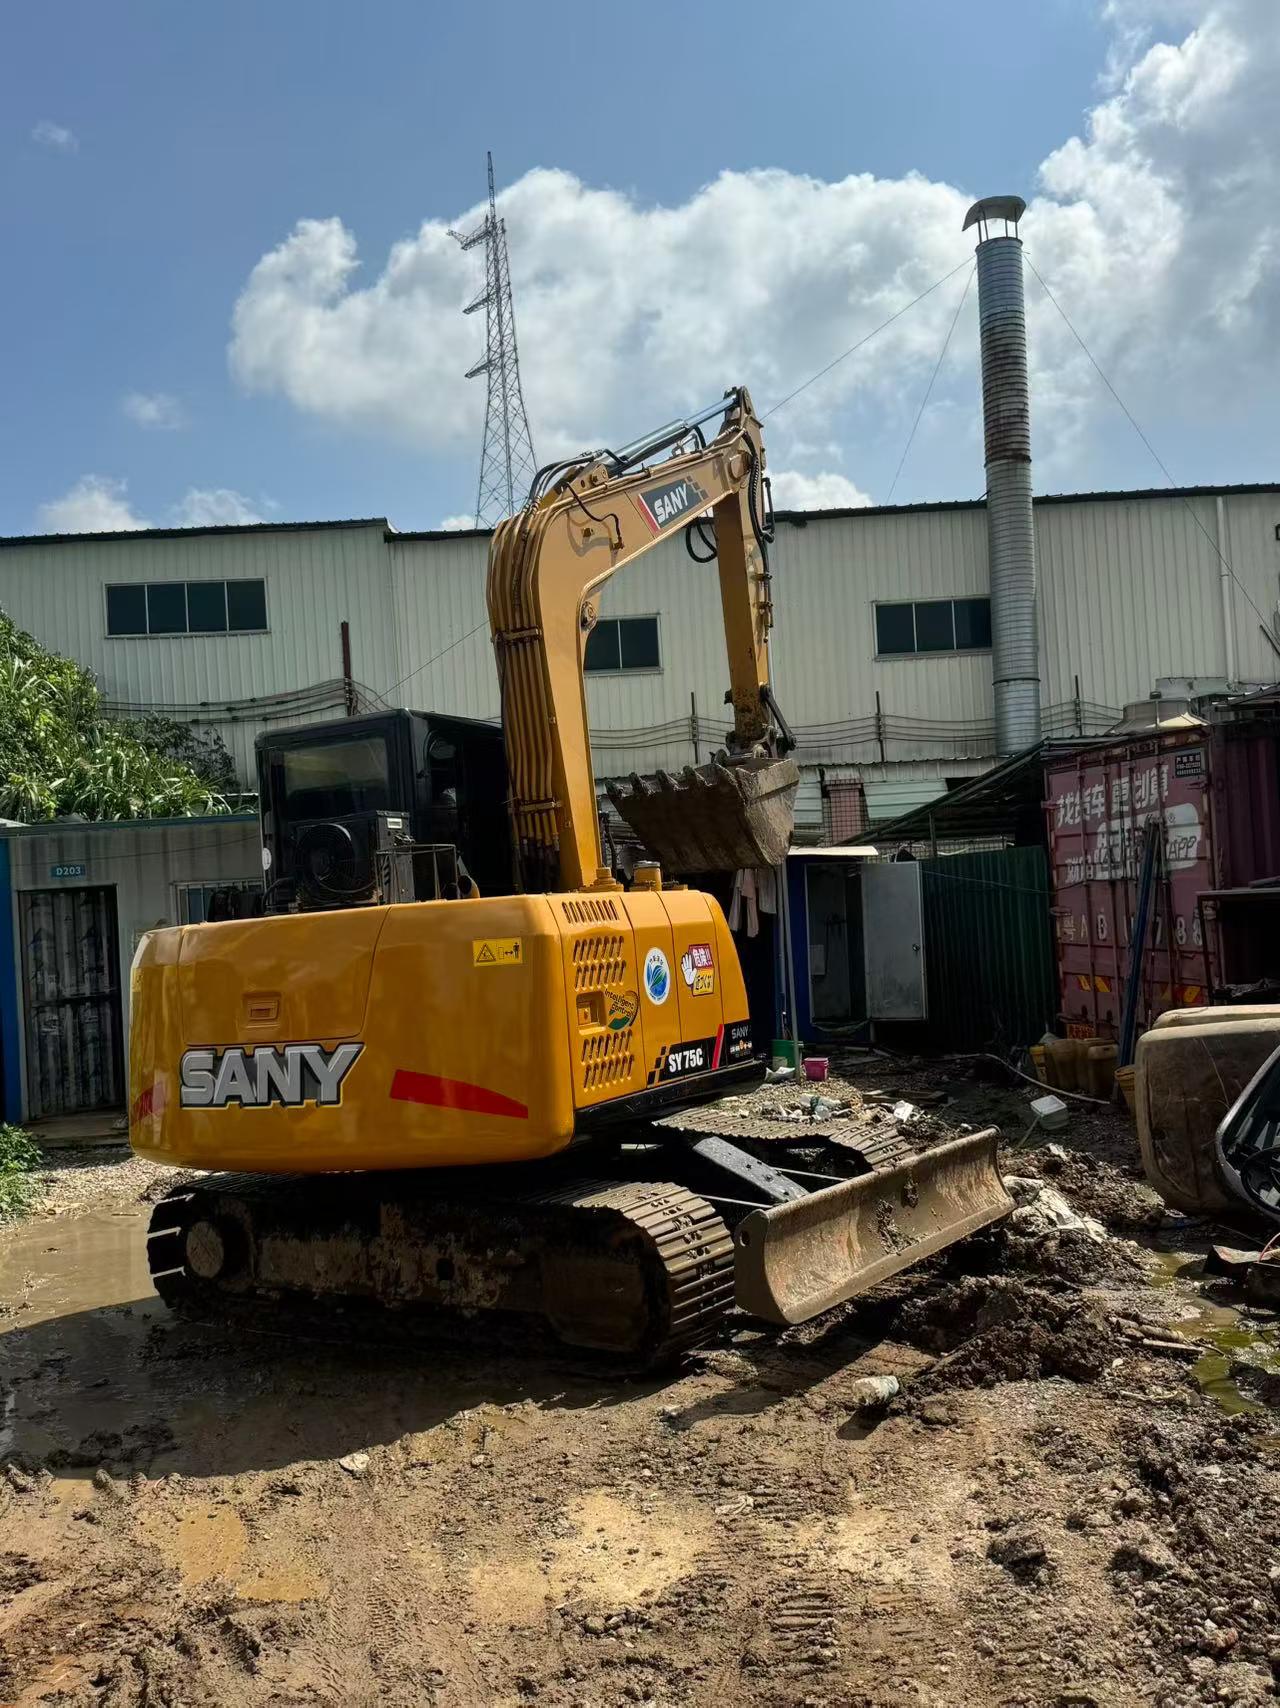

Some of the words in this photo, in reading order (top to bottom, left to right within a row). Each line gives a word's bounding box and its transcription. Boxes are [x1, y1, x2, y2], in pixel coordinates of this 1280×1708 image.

[654, 483, 688, 523] SANY
[1168, 835, 1197, 860] APP
[56, 865, 81, 876] D203
[731, 1025, 748, 1039] SANY
[180, 1043, 364, 1106] SANY
